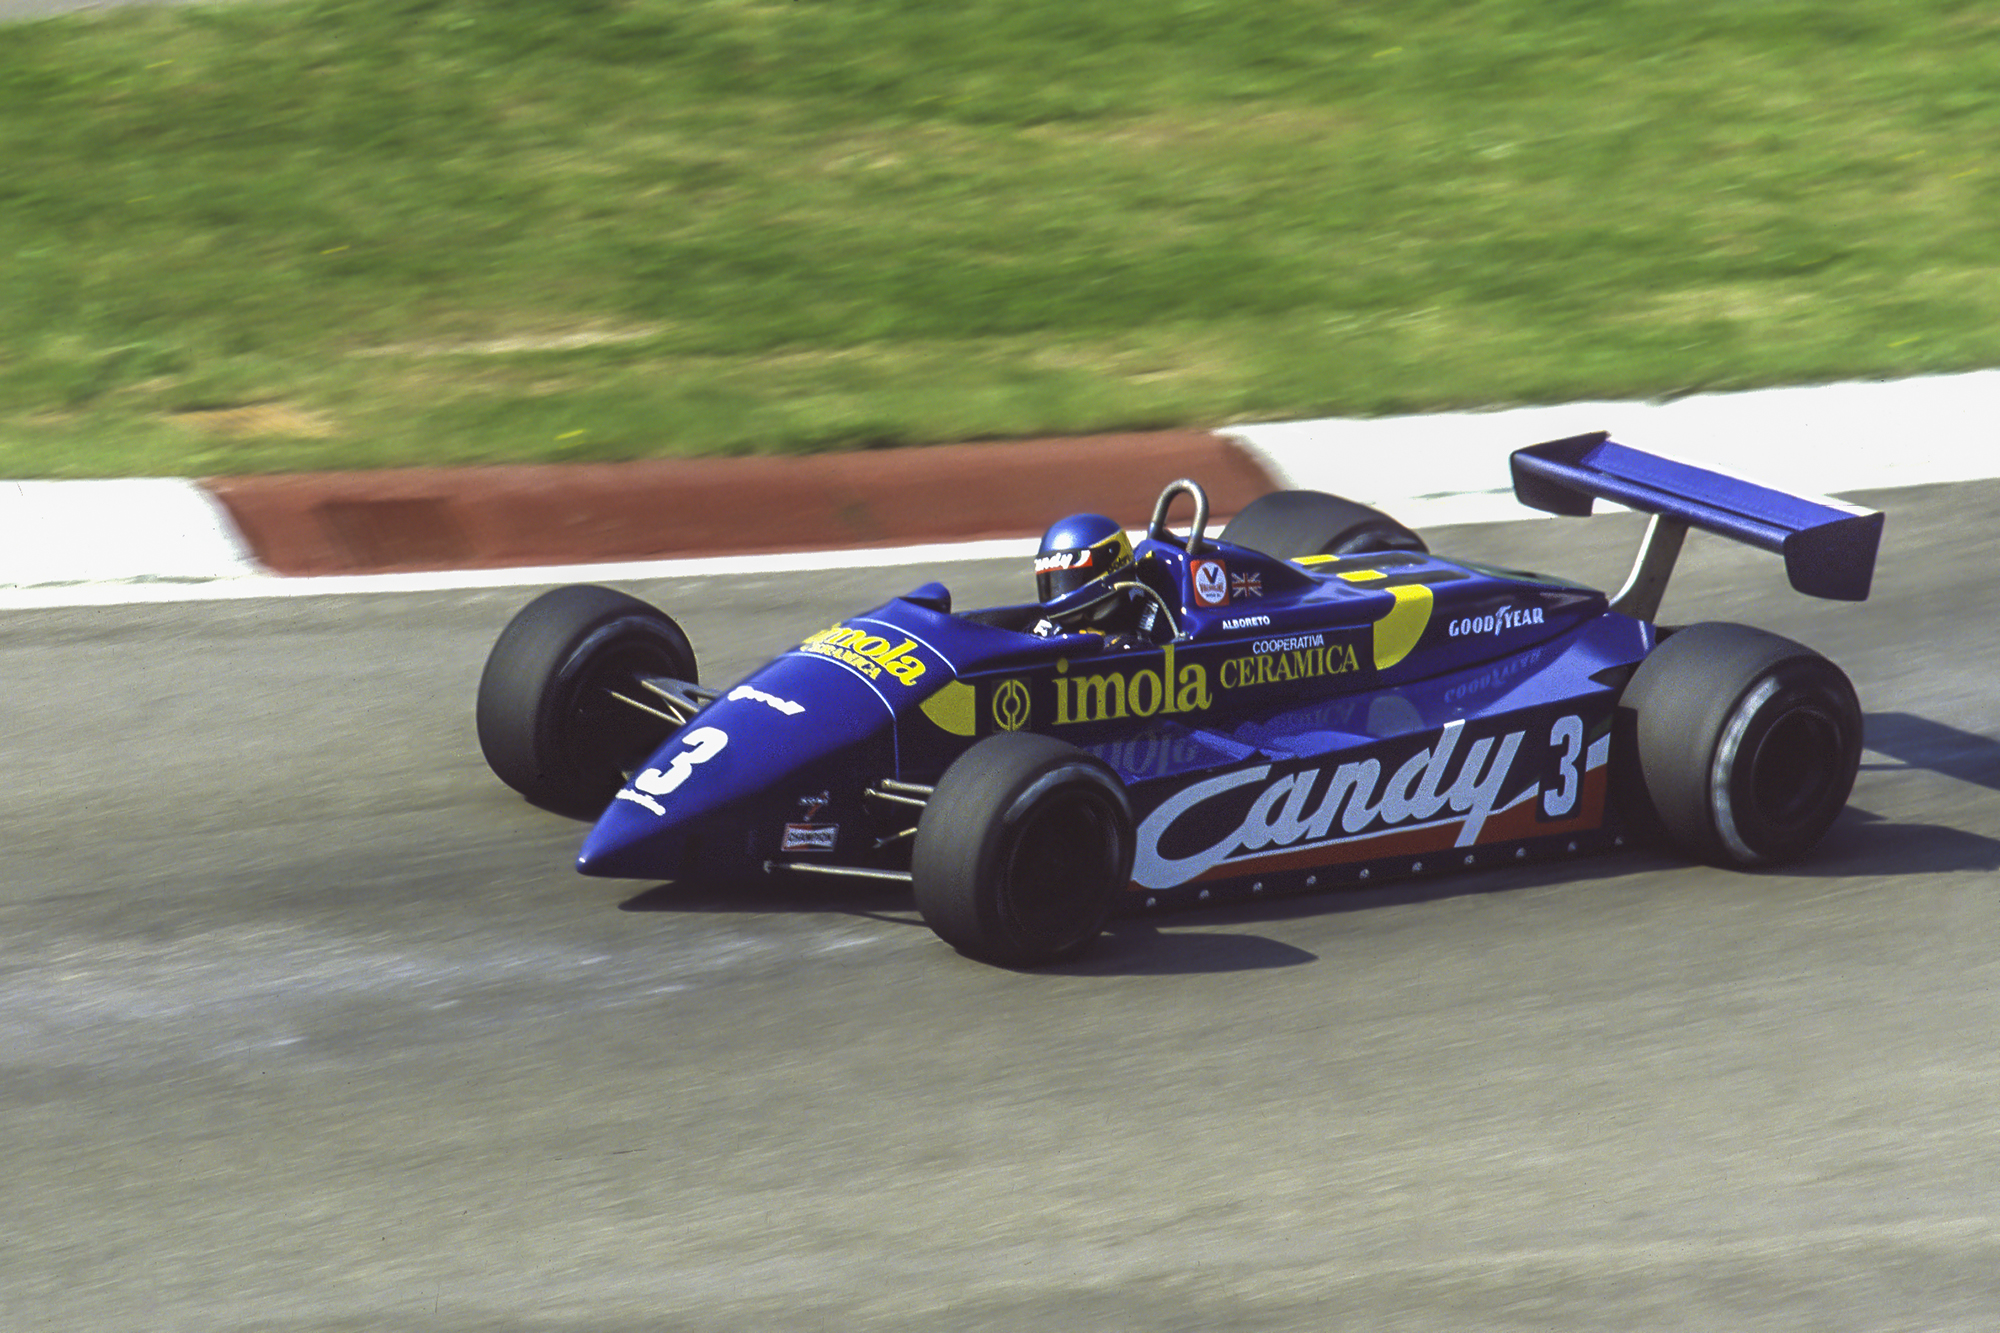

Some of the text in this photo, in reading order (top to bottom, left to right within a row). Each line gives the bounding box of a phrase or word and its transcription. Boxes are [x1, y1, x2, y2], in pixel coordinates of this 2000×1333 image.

[1222, 615, 1271, 630] ALBORETO
[1252, 633, 1325, 655] COOPERATIVA
[1448, 605, 1545, 636] GOODYEAR
[1051, 643, 1213, 726] imola
[1219, 643, 1360, 689] CERAMICA
[634, 726, 729, 795] 3
[1543, 714, 1584, 817] 3
[1131, 719, 1528, 889] Candy
